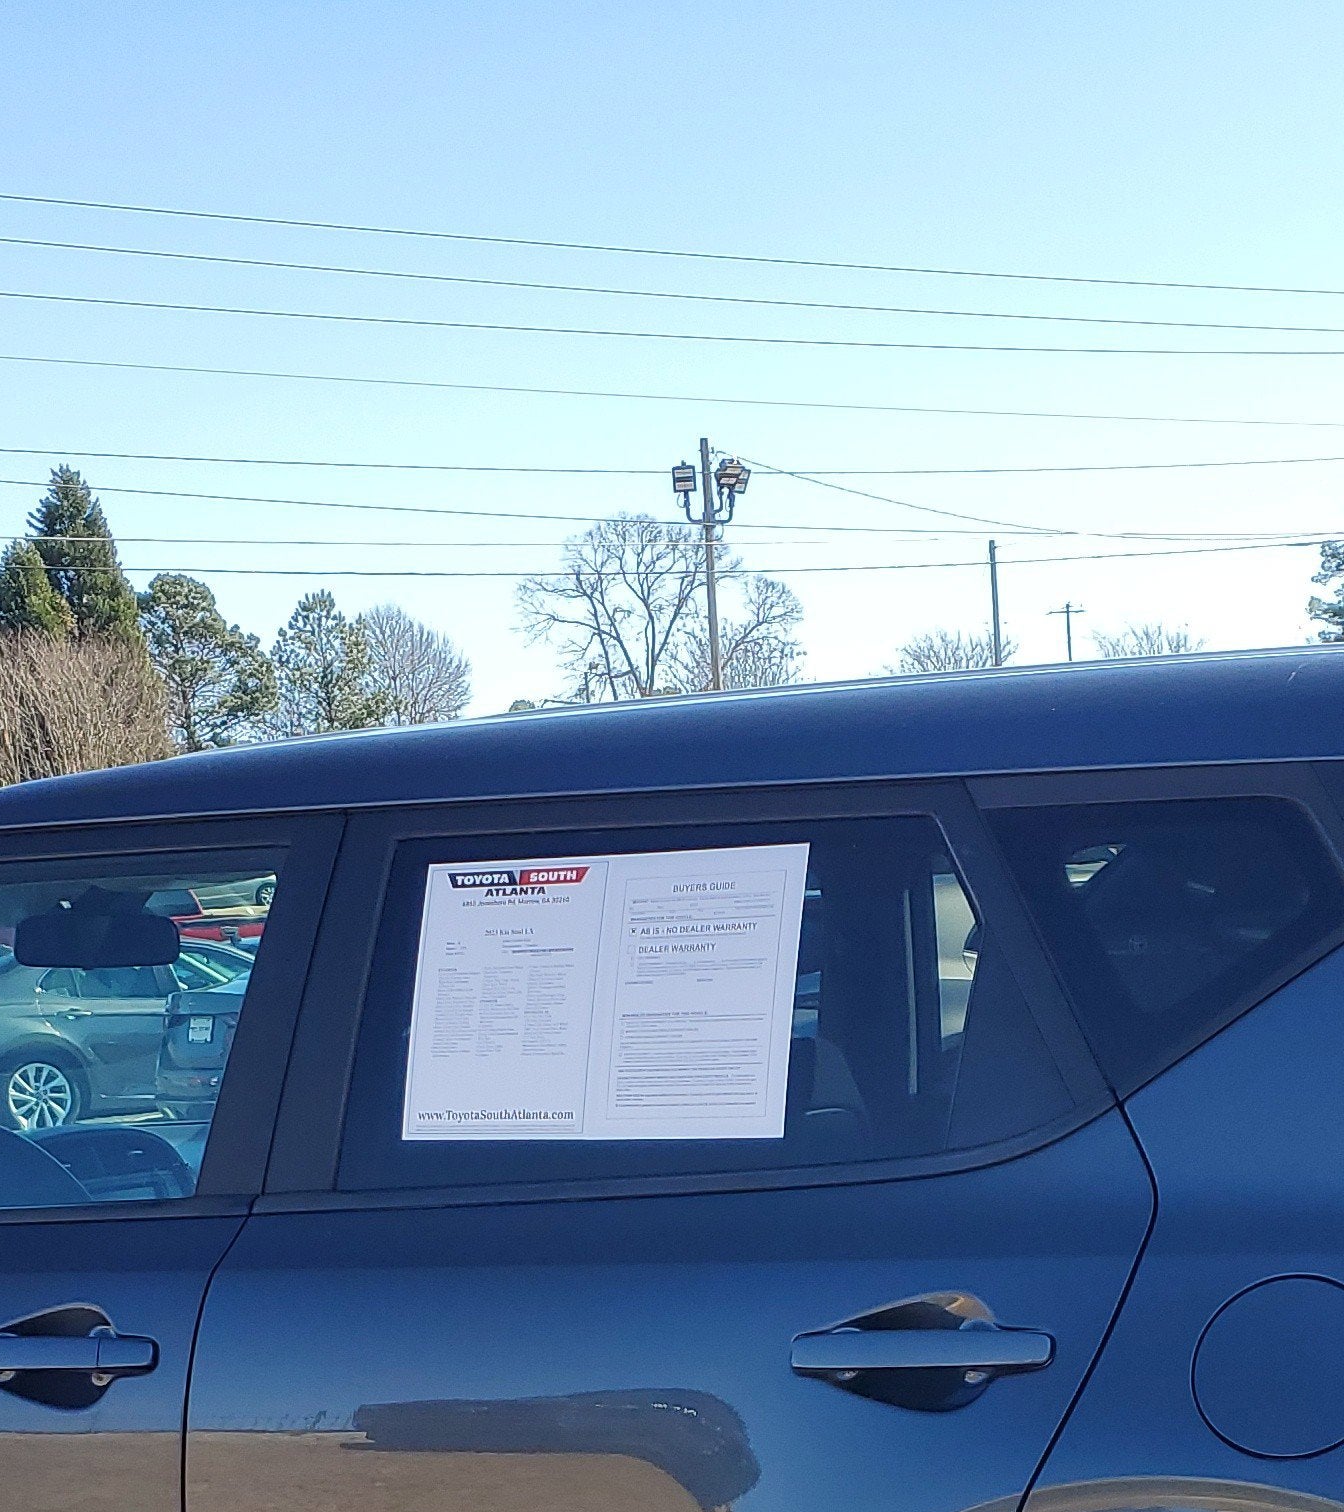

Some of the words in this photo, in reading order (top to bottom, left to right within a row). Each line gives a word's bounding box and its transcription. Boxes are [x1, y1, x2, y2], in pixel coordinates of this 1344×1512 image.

[455, 873, 509, 886] TOYOTA
[529, 869, 577, 882] SOUTH
[484, 886, 546, 898] ATLANTA
[672, 883, 708, 893] BUYERS
[709, 881, 737, 891] GUIDE
[666, 926, 678, 934] NO
[679, 924, 711, 933] DEALER
[713, 922, 758, 931] WARRANTY
[638, 945, 670, 954] DEALER
[671, 943, 717, 953] WARRANTY
[417, 1109, 574, 1123] www.ToyotaSouthAtlanta.com
